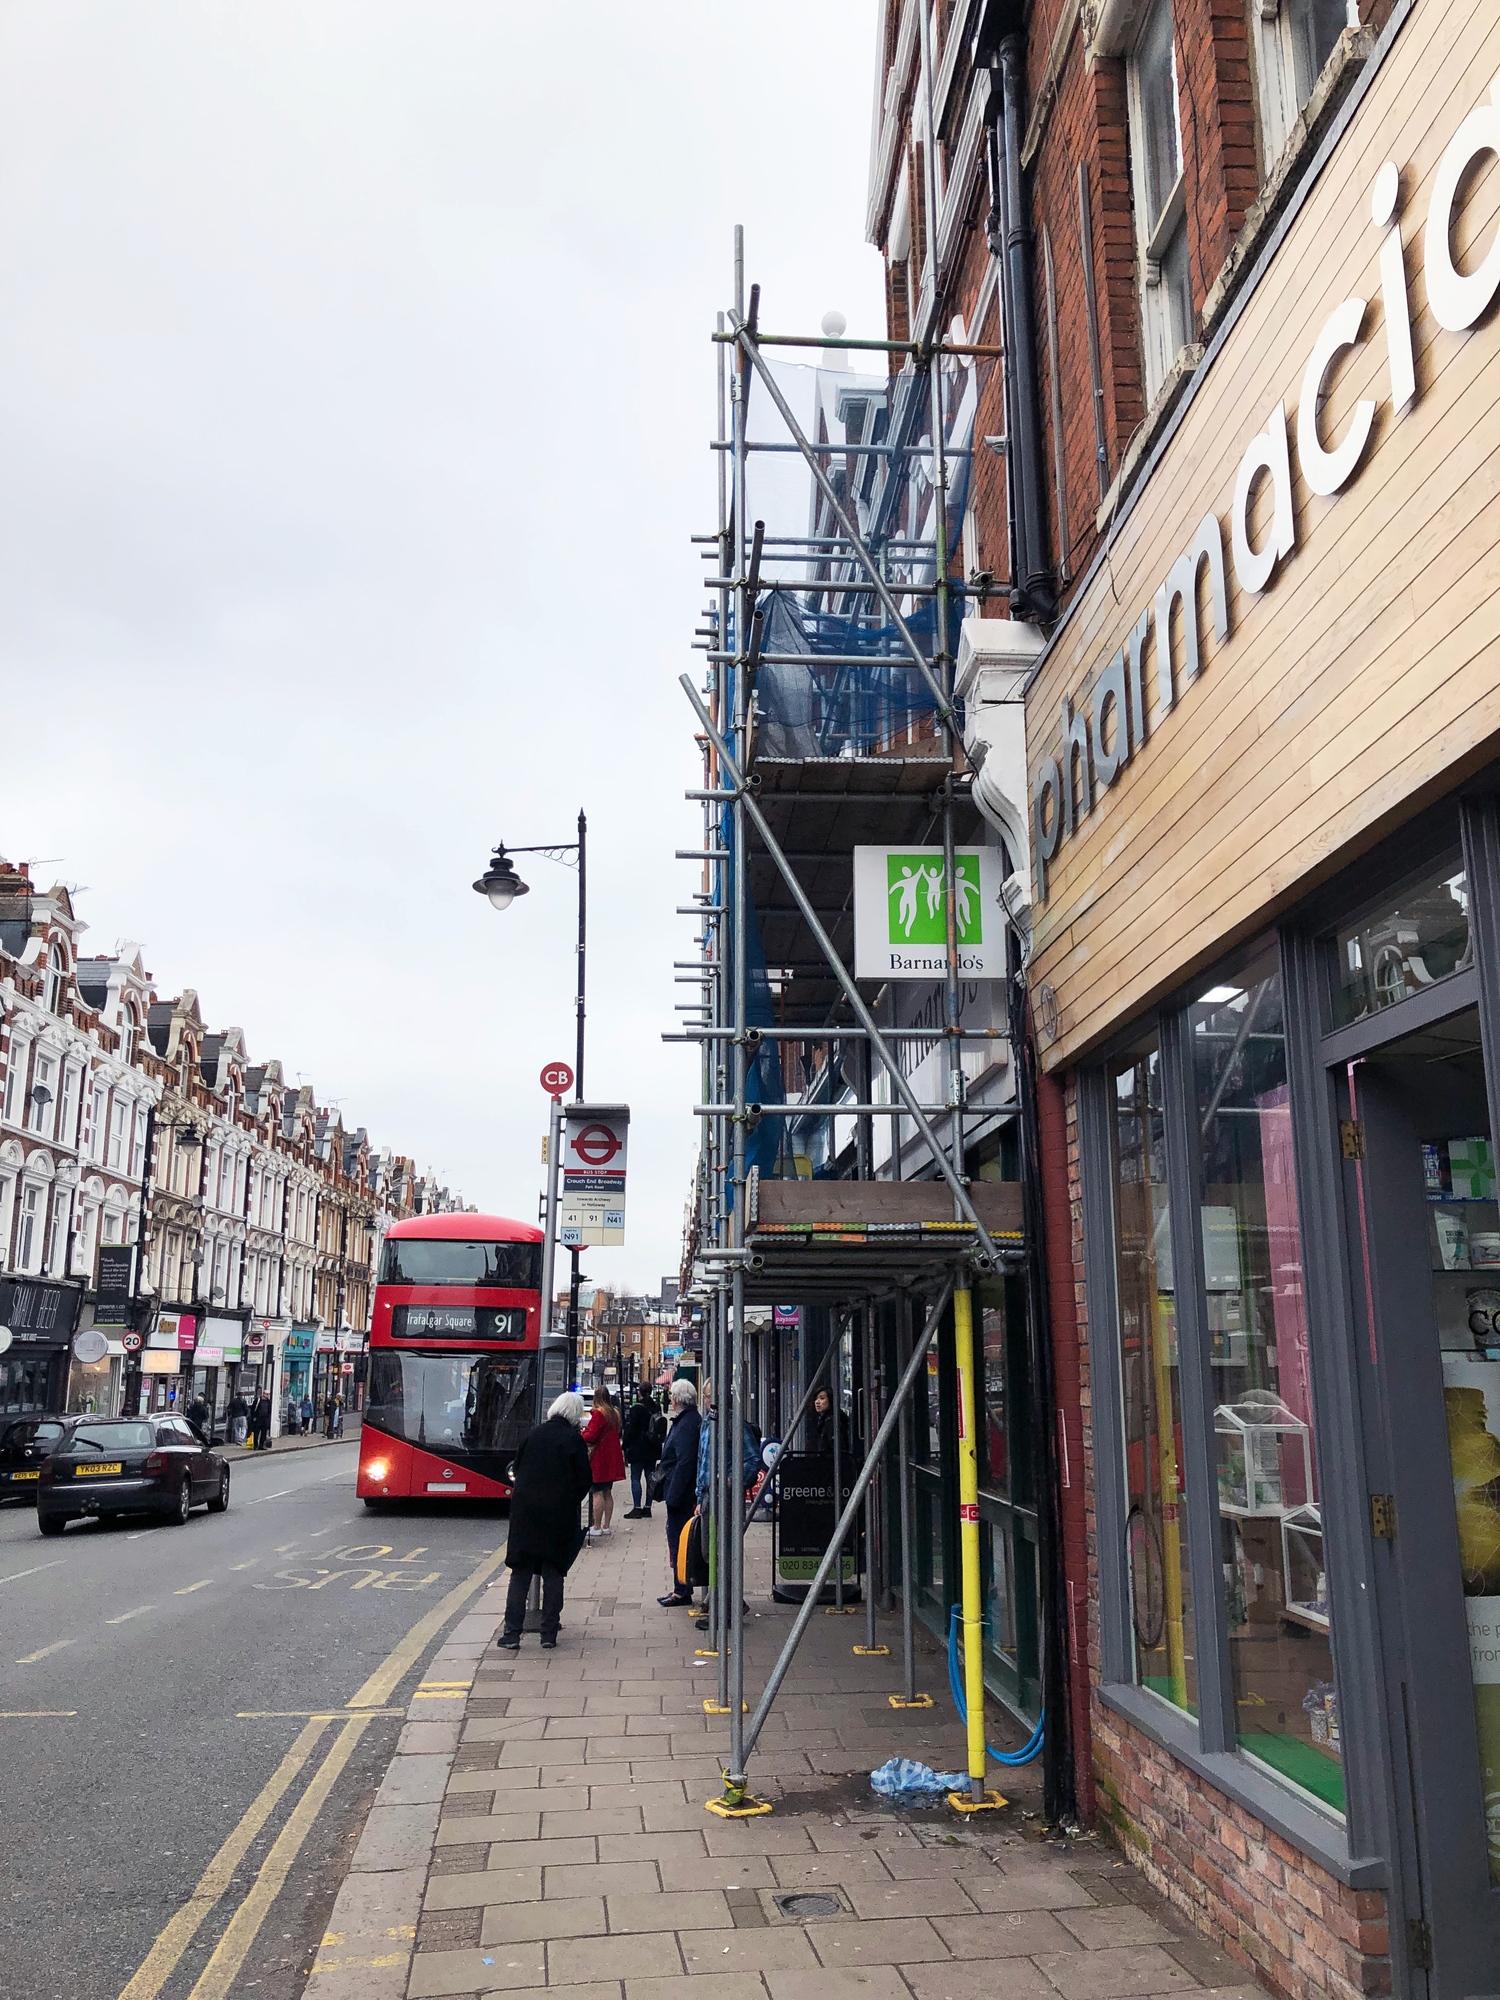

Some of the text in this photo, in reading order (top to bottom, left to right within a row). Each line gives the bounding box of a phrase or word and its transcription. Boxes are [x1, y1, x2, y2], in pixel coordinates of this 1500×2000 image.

[544, 1071, 569, 1085] CB
[597, 1178, 623, 1186] Broadway
[589, 1214, 598, 1222] 91
[8, 1286, 61, 1329] SMALL BEER
[406, 1312, 472, 1329] Trafalgar Square
[494, 1314, 512, 1334] 91
[125, 1337, 140, 1346] 20
[80, 1463, 118, 1474] YK03 RZC
[782, 1560, 800, 1570] 020
[802, 1560, 821, 1570] 834
